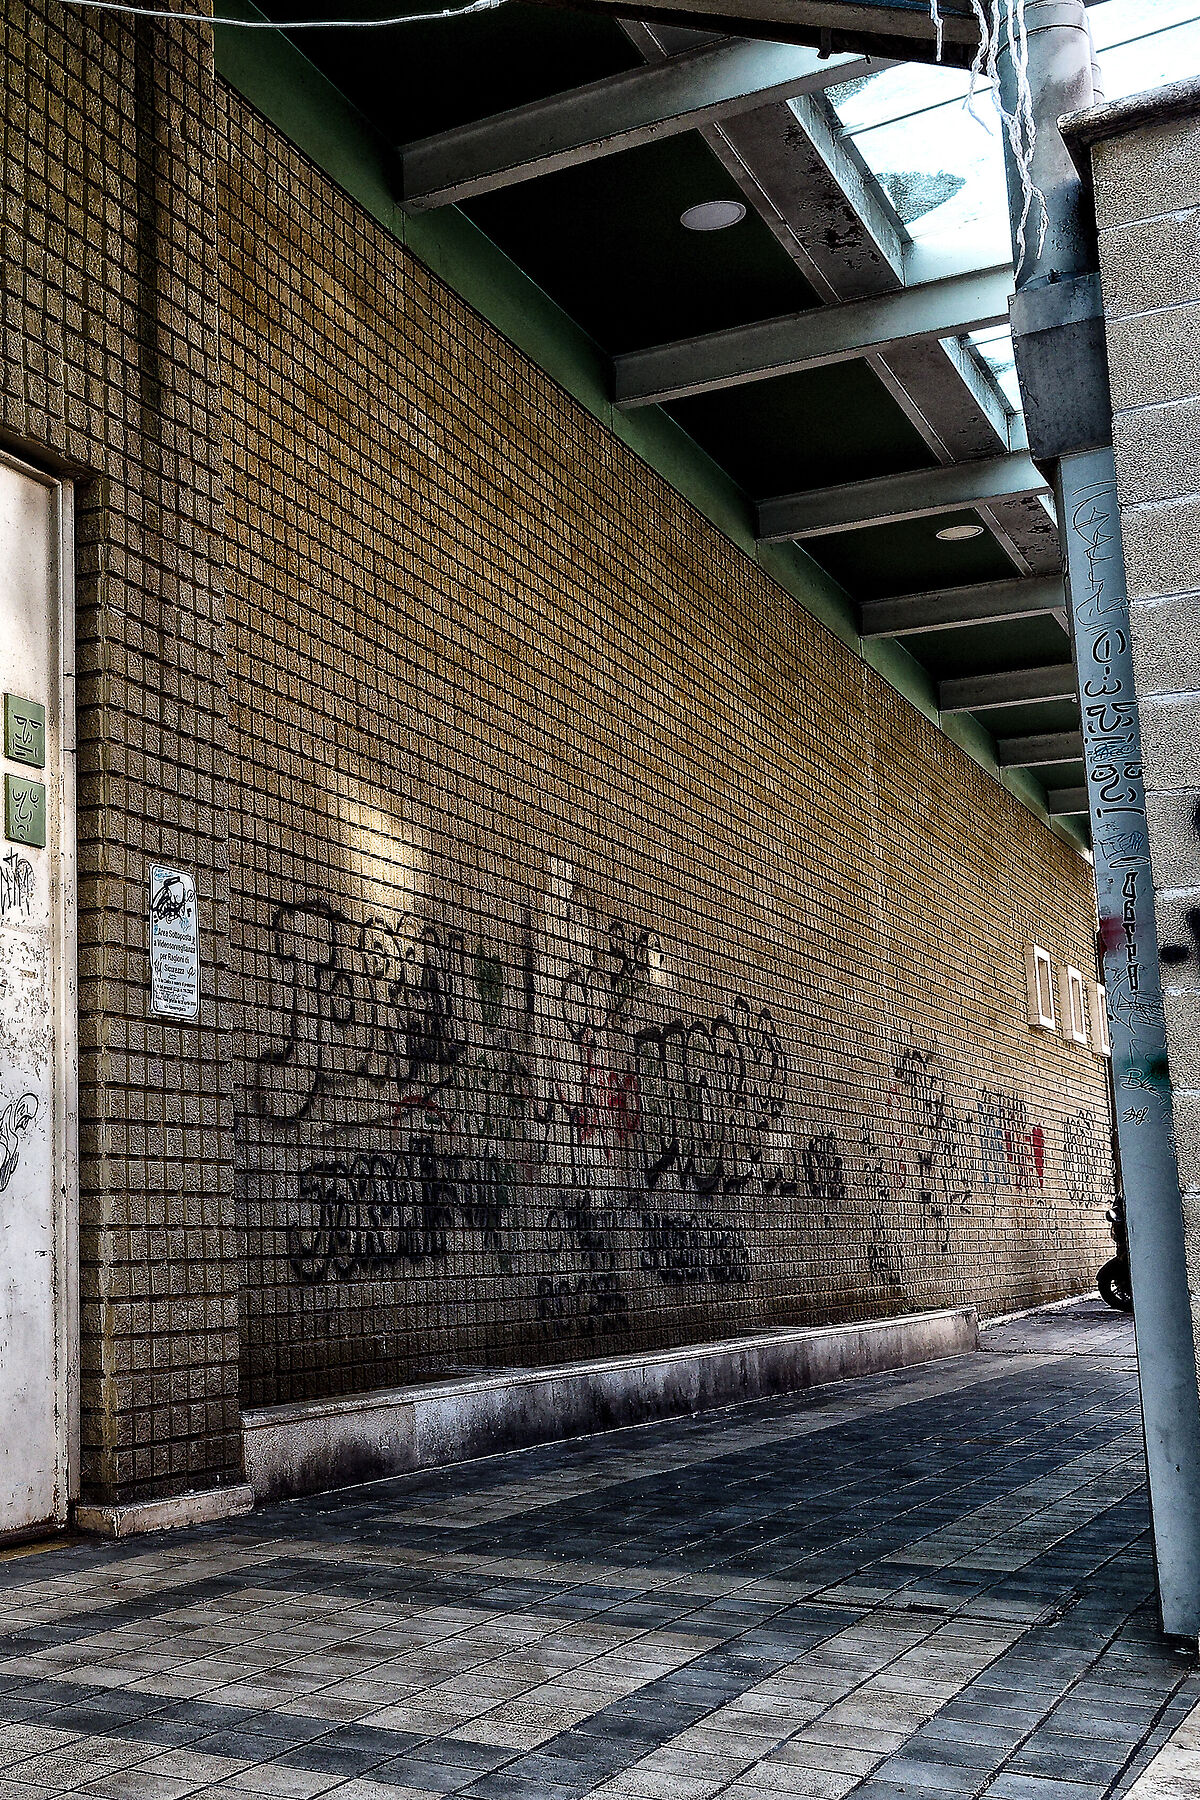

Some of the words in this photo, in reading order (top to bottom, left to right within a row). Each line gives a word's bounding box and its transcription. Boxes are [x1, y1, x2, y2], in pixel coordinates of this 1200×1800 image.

[158, 928, 169, 938] Area
[169, 930, 192, 941] Sottoposta
[157, 939, 196, 954] Videosorveglianza
[168, 953, 184, 964] Ragioni
[164, 964, 185, 975] Sicurezza
